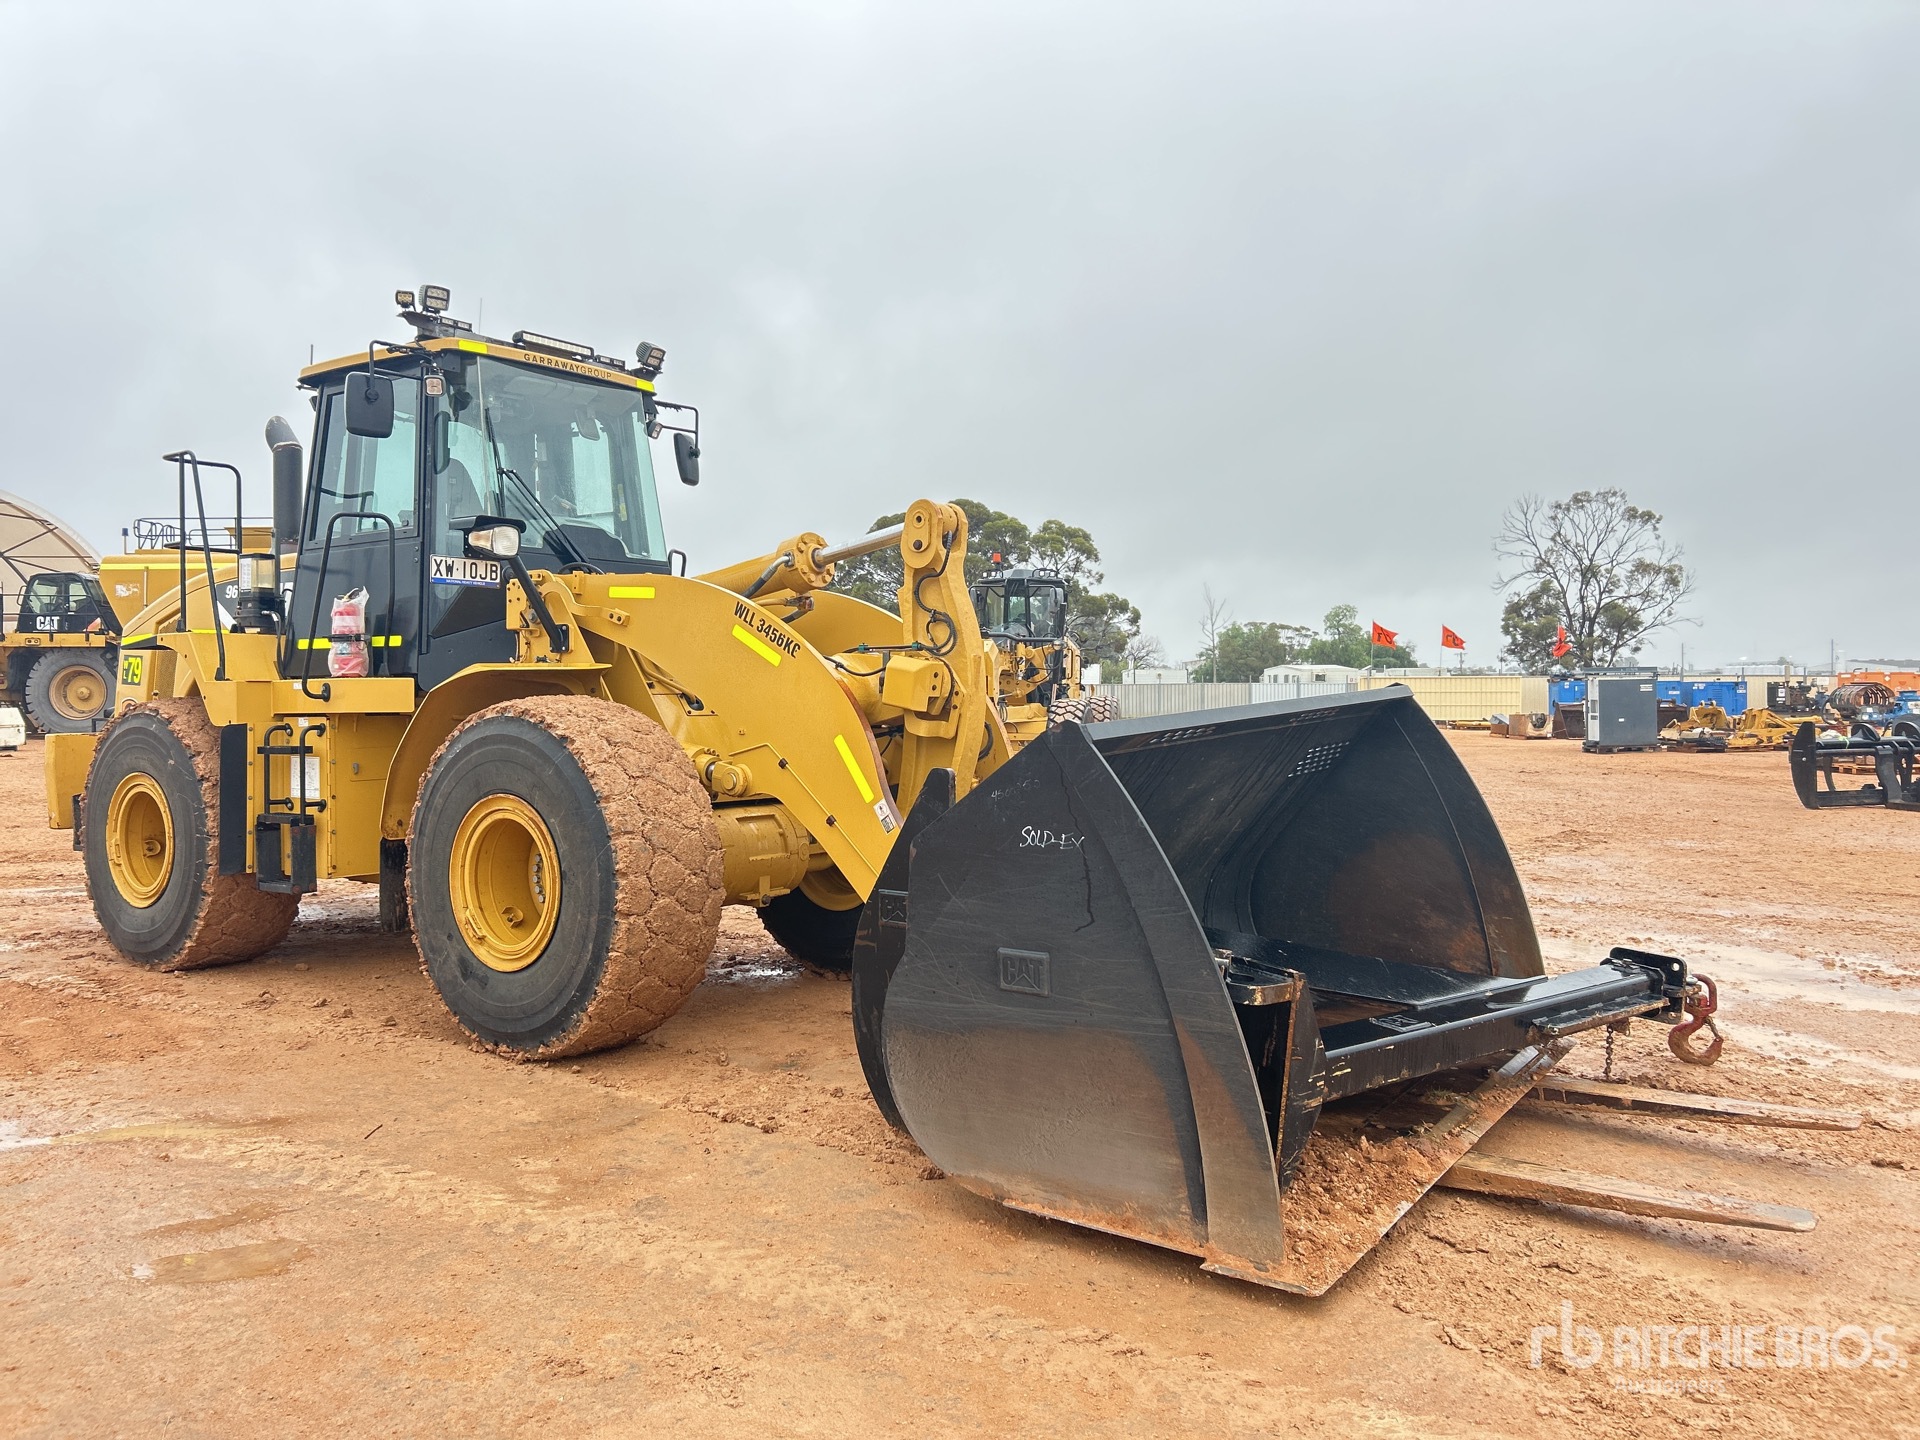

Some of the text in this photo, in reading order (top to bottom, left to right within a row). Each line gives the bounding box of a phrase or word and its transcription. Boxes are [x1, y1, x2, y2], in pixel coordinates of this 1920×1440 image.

[36, 616, 60, 631] CAT
[734, 601, 756, 628] WLL
[127, 656, 142, 684] 79
[1001, 955, 1047, 990] CAT
